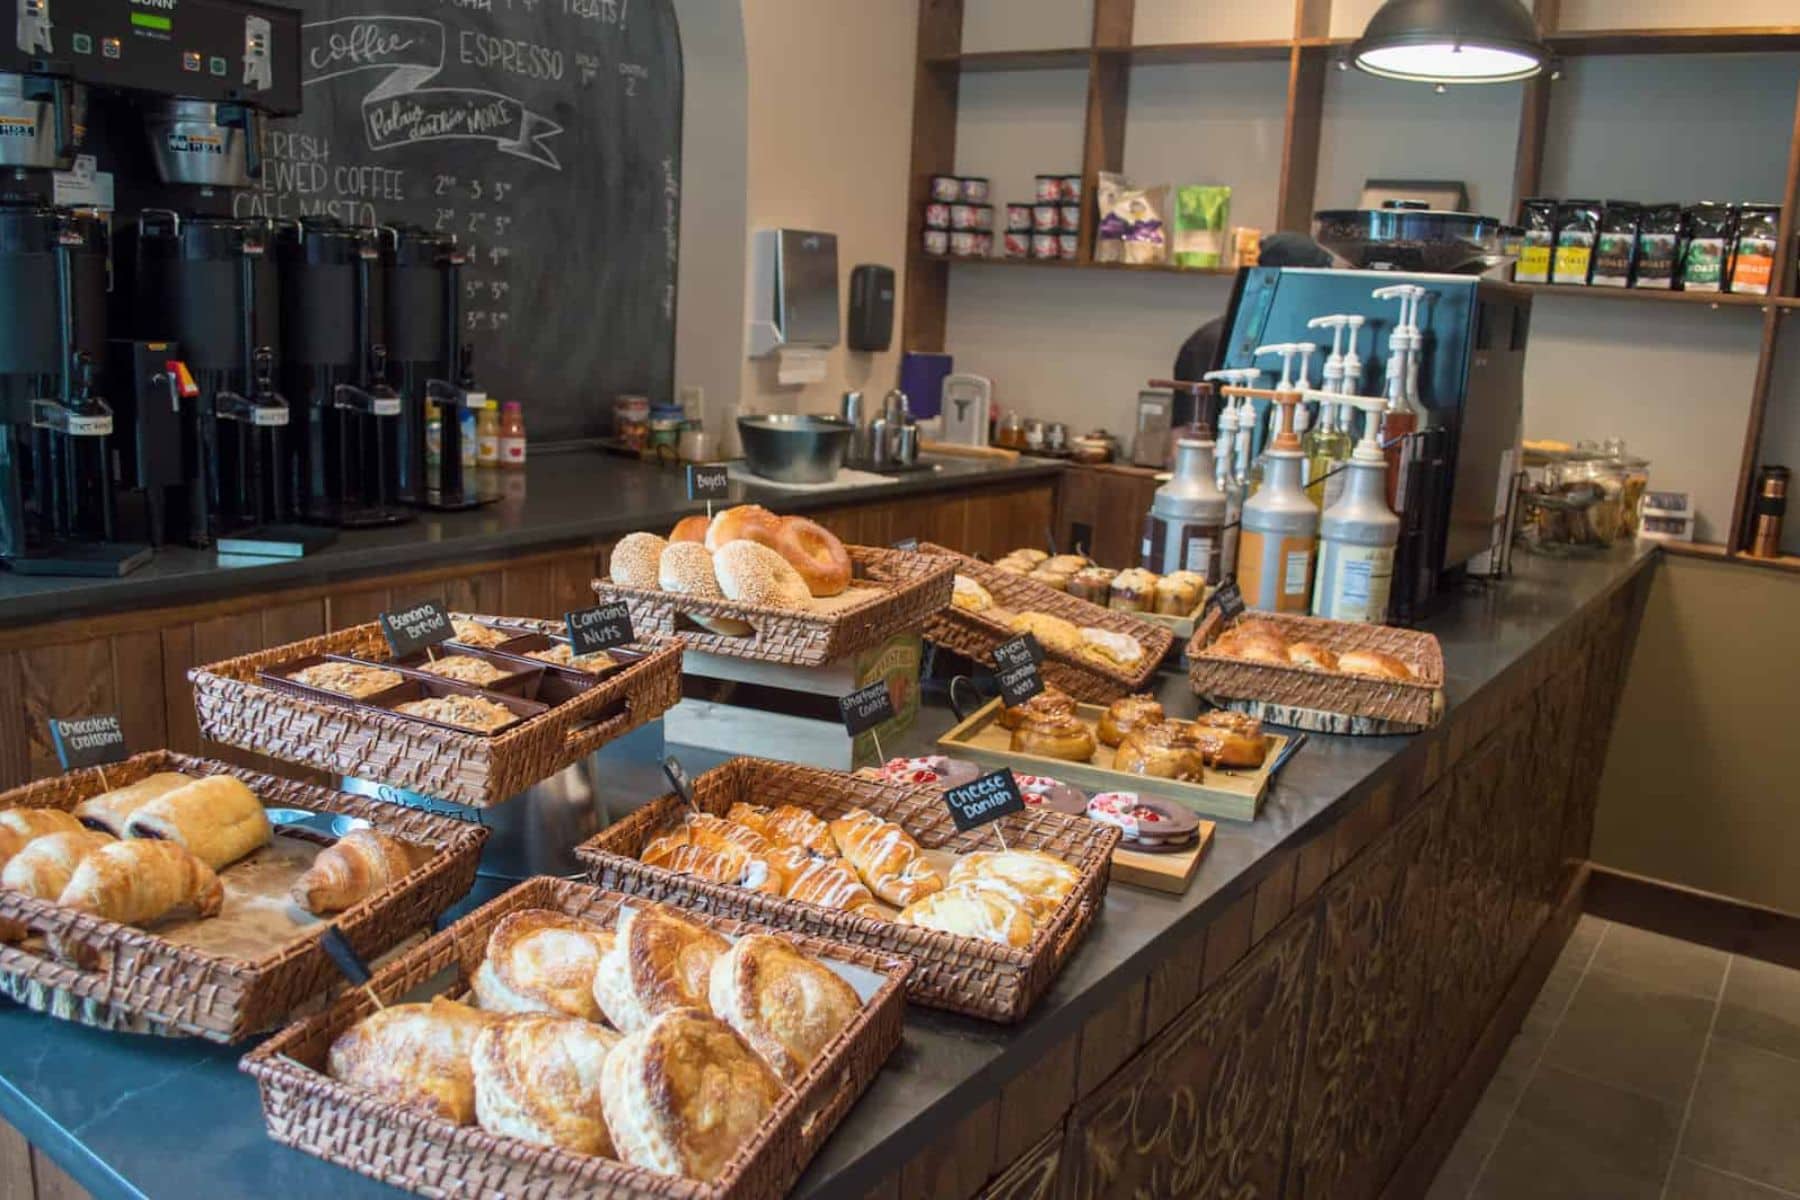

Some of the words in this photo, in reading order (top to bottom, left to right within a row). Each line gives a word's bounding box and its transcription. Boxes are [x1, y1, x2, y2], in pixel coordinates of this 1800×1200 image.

[459, 30, 564, 80] ESPRESSO
[334, 166, 405, 201] COFFEE
[388, 604, 435, 630] Banana
[406, 613, 444, 639] Bread
[948, 775, 1006, 808] Cheese
